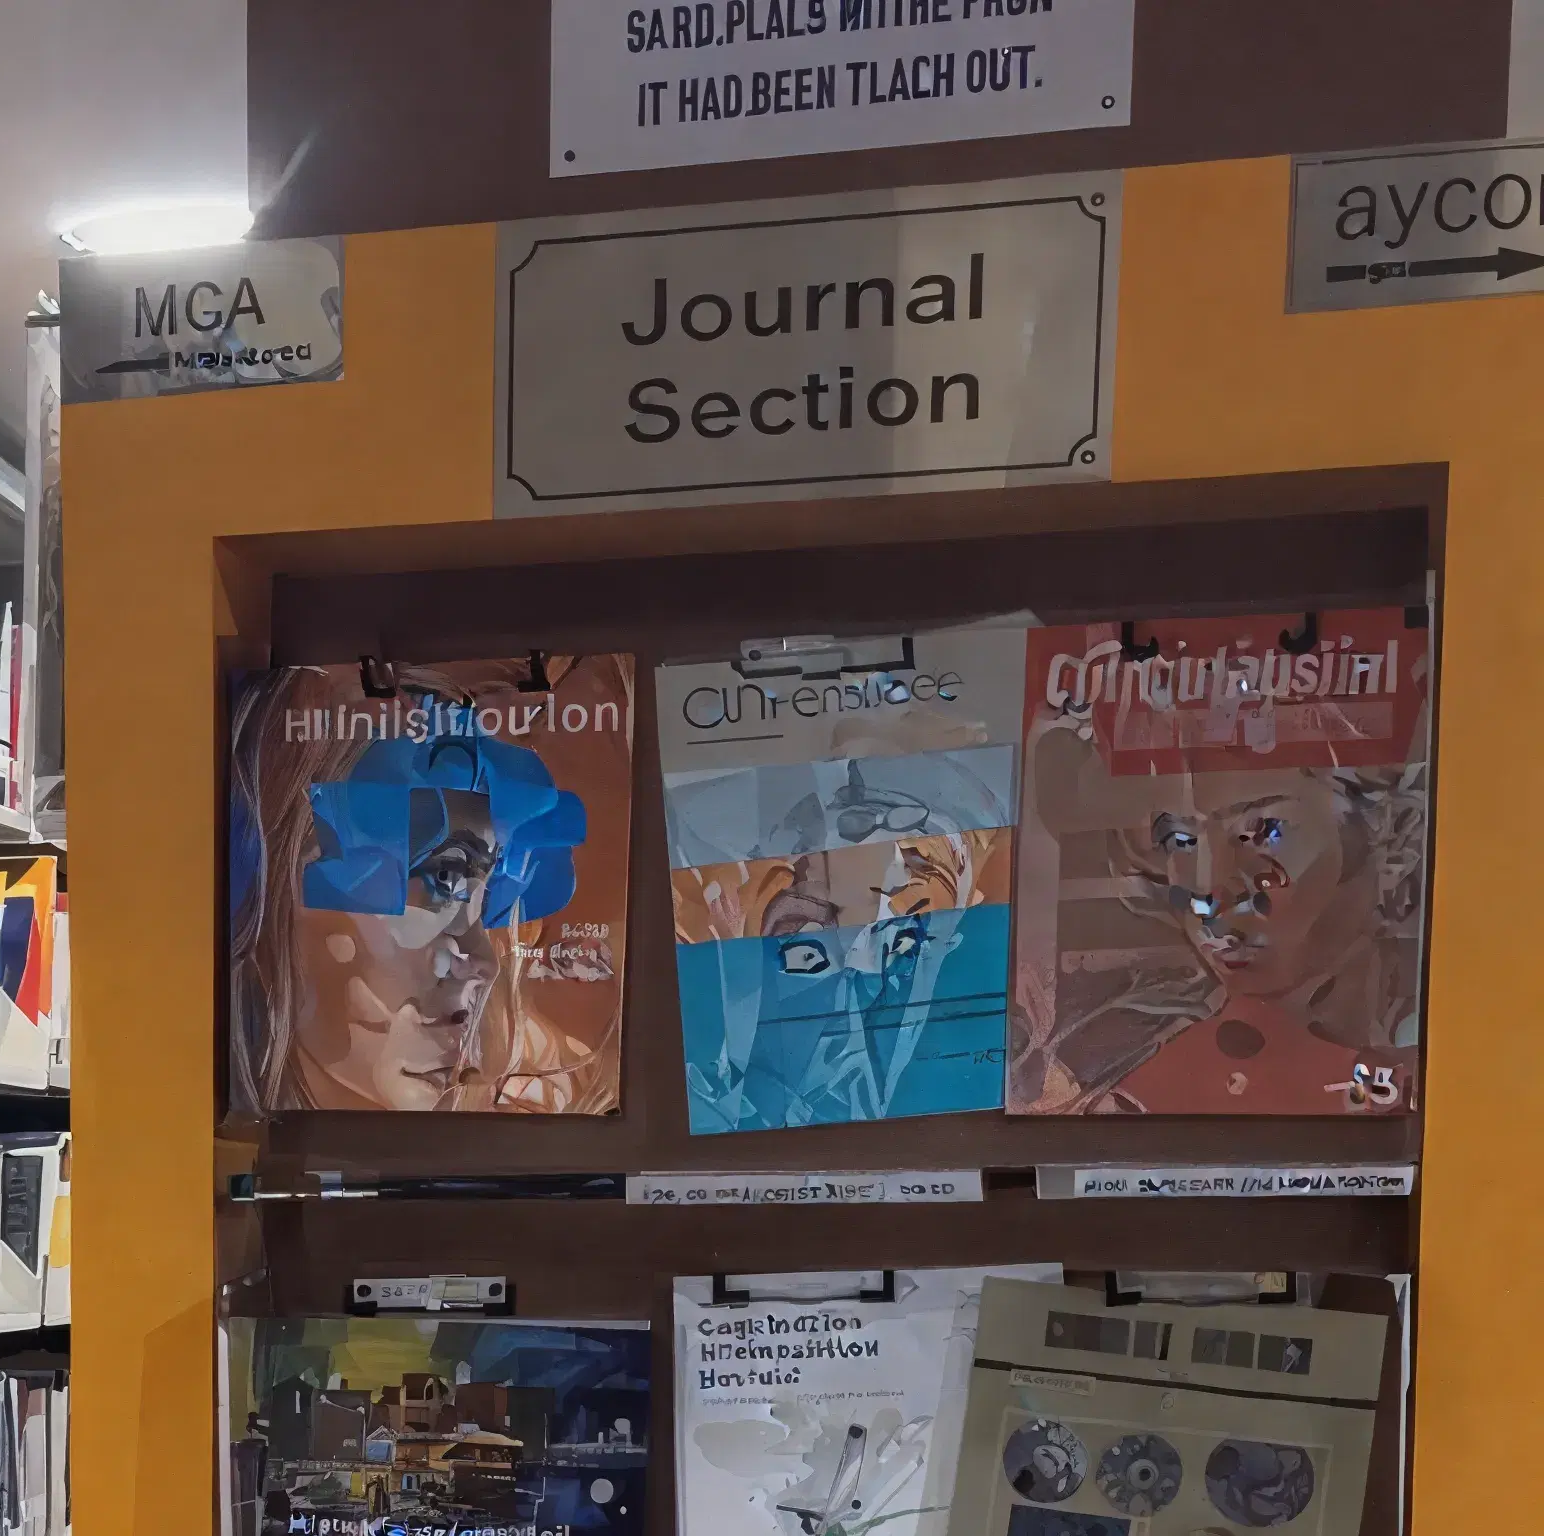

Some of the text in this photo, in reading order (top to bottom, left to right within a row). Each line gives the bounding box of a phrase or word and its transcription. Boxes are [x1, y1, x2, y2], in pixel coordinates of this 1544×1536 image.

[638, 81, 668, 127] IT
[1334, 172, 1544, 250] ayco
[620, 252, 985, 346] Journal
[623, 366, 981, 444] Section
